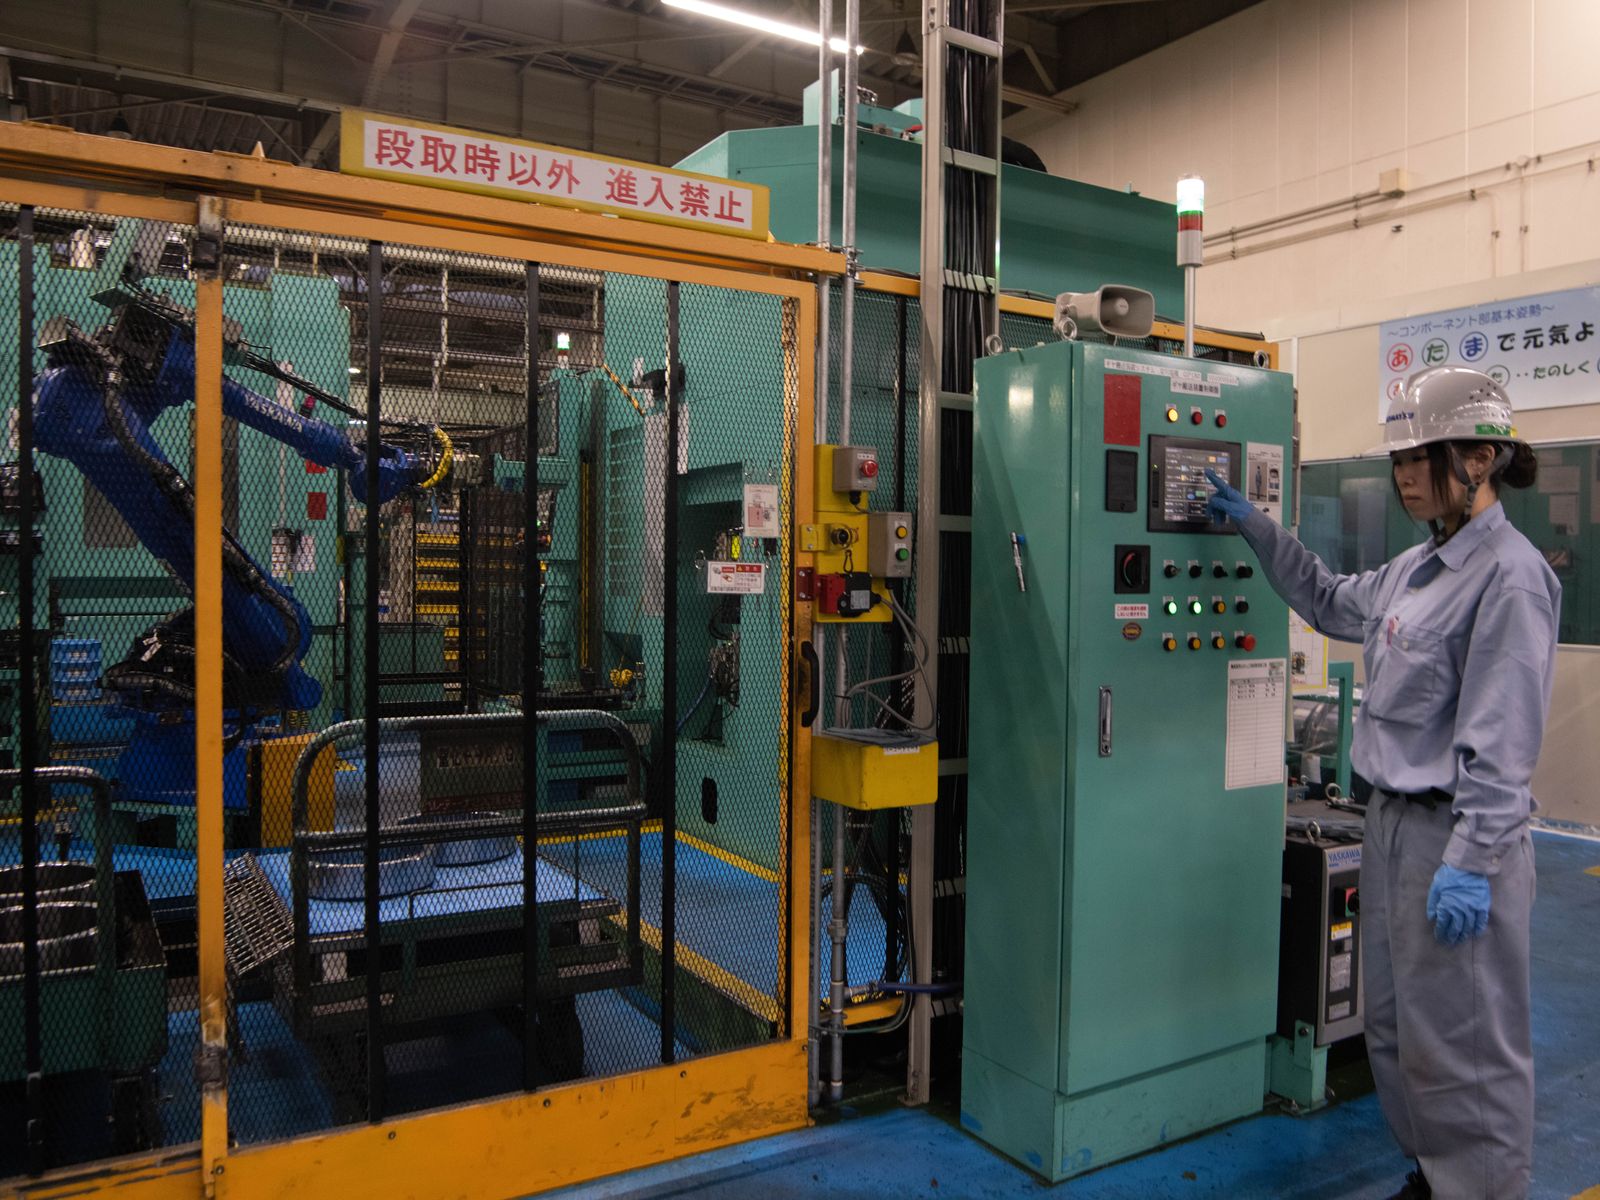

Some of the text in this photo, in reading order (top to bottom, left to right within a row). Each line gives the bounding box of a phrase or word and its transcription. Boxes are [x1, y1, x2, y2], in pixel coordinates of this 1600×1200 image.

[374, 127, 745, 224] 段取時以外 進入禁止
[244, 391, 303, 433] YASKAWA
[1327, 848, 1361, 862] YASKAWA
